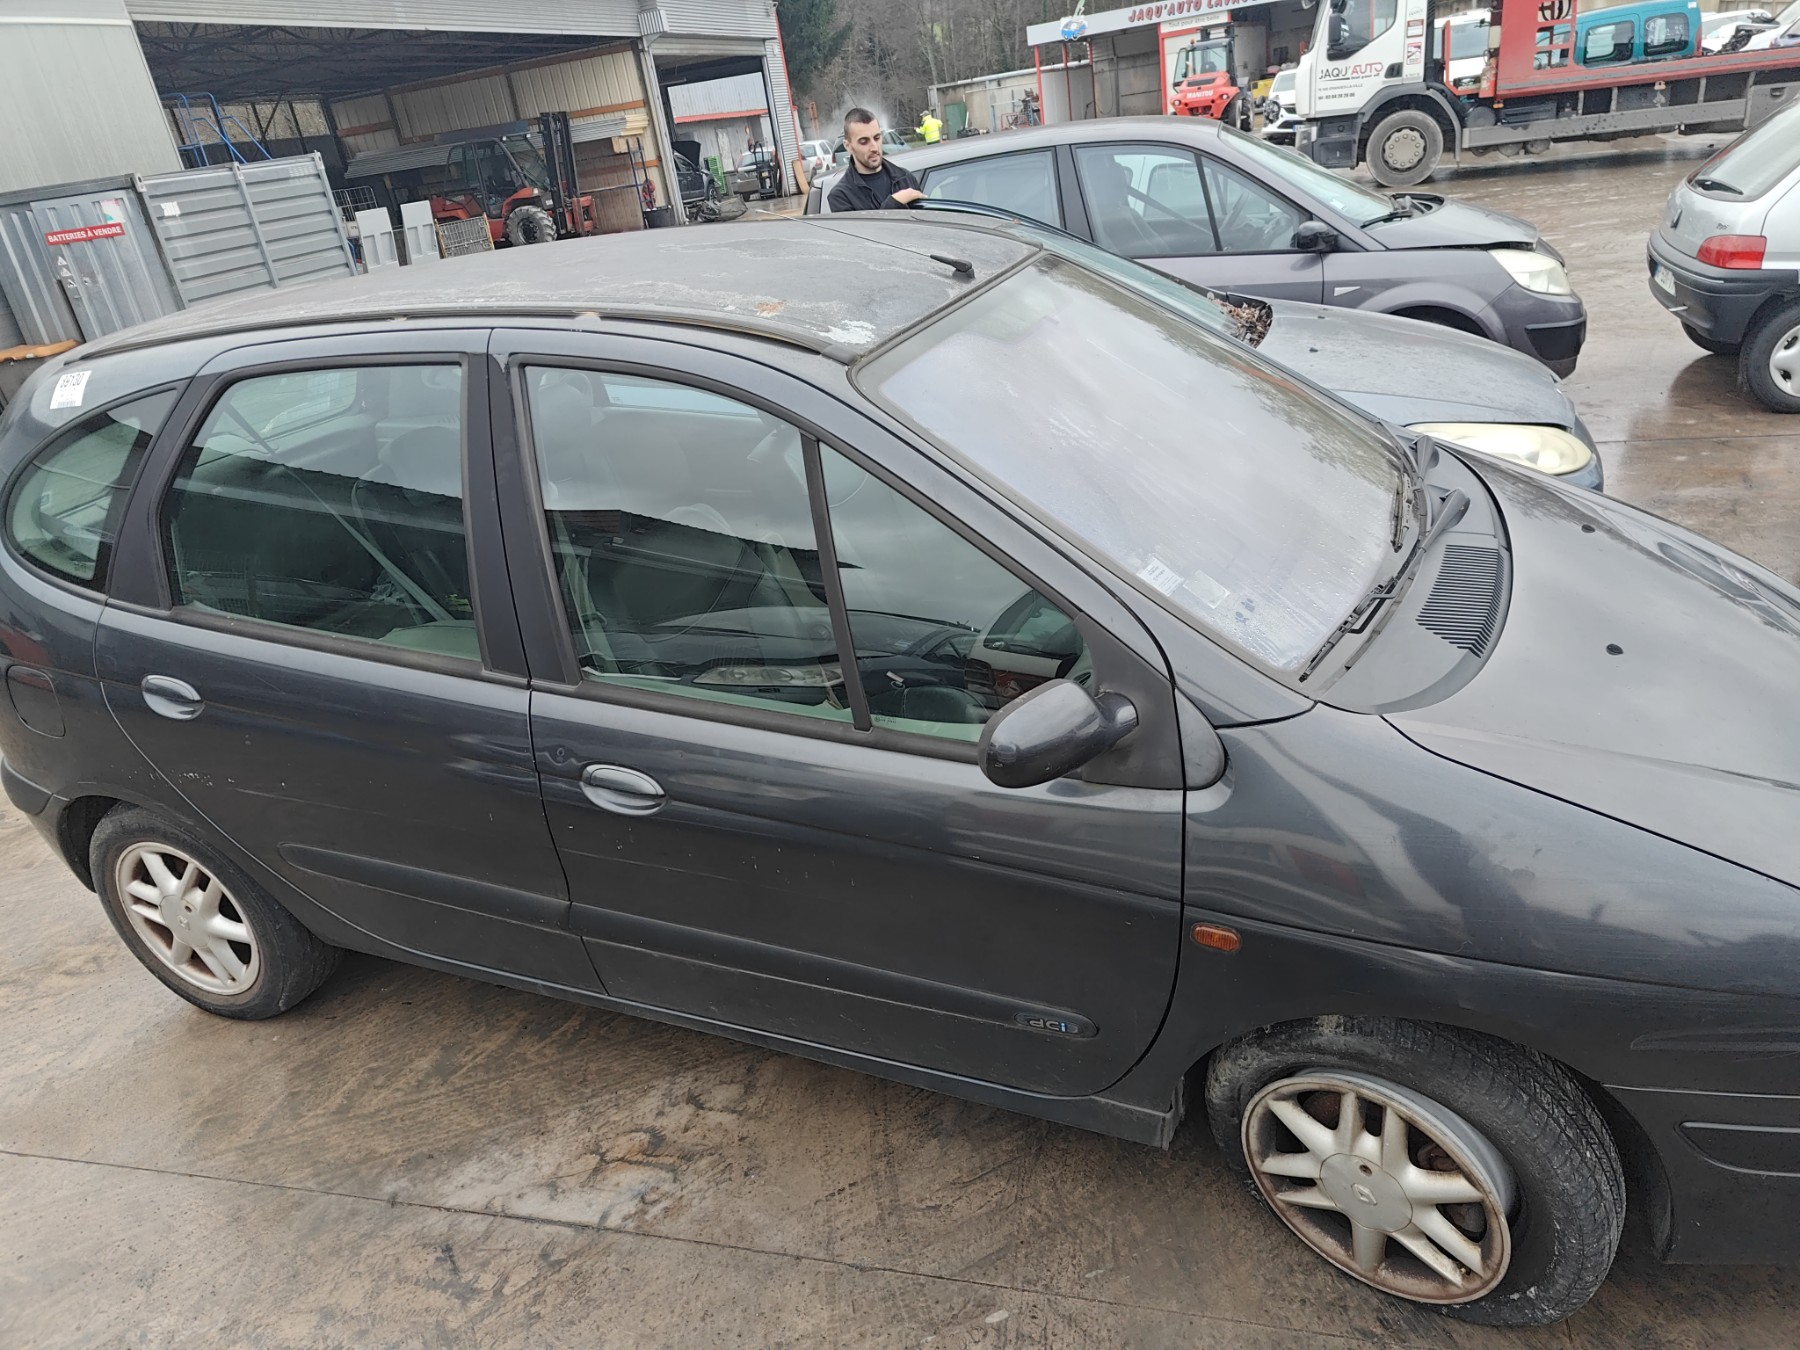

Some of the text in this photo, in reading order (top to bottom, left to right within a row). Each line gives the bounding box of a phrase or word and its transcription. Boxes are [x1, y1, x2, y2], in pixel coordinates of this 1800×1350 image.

[1128, 0, 1202, 22] JAQU'AUTO
[1186, 89, 1214, 99] MANITOU
[47, 226, 122, 243] BATTERIES À VENDRE
